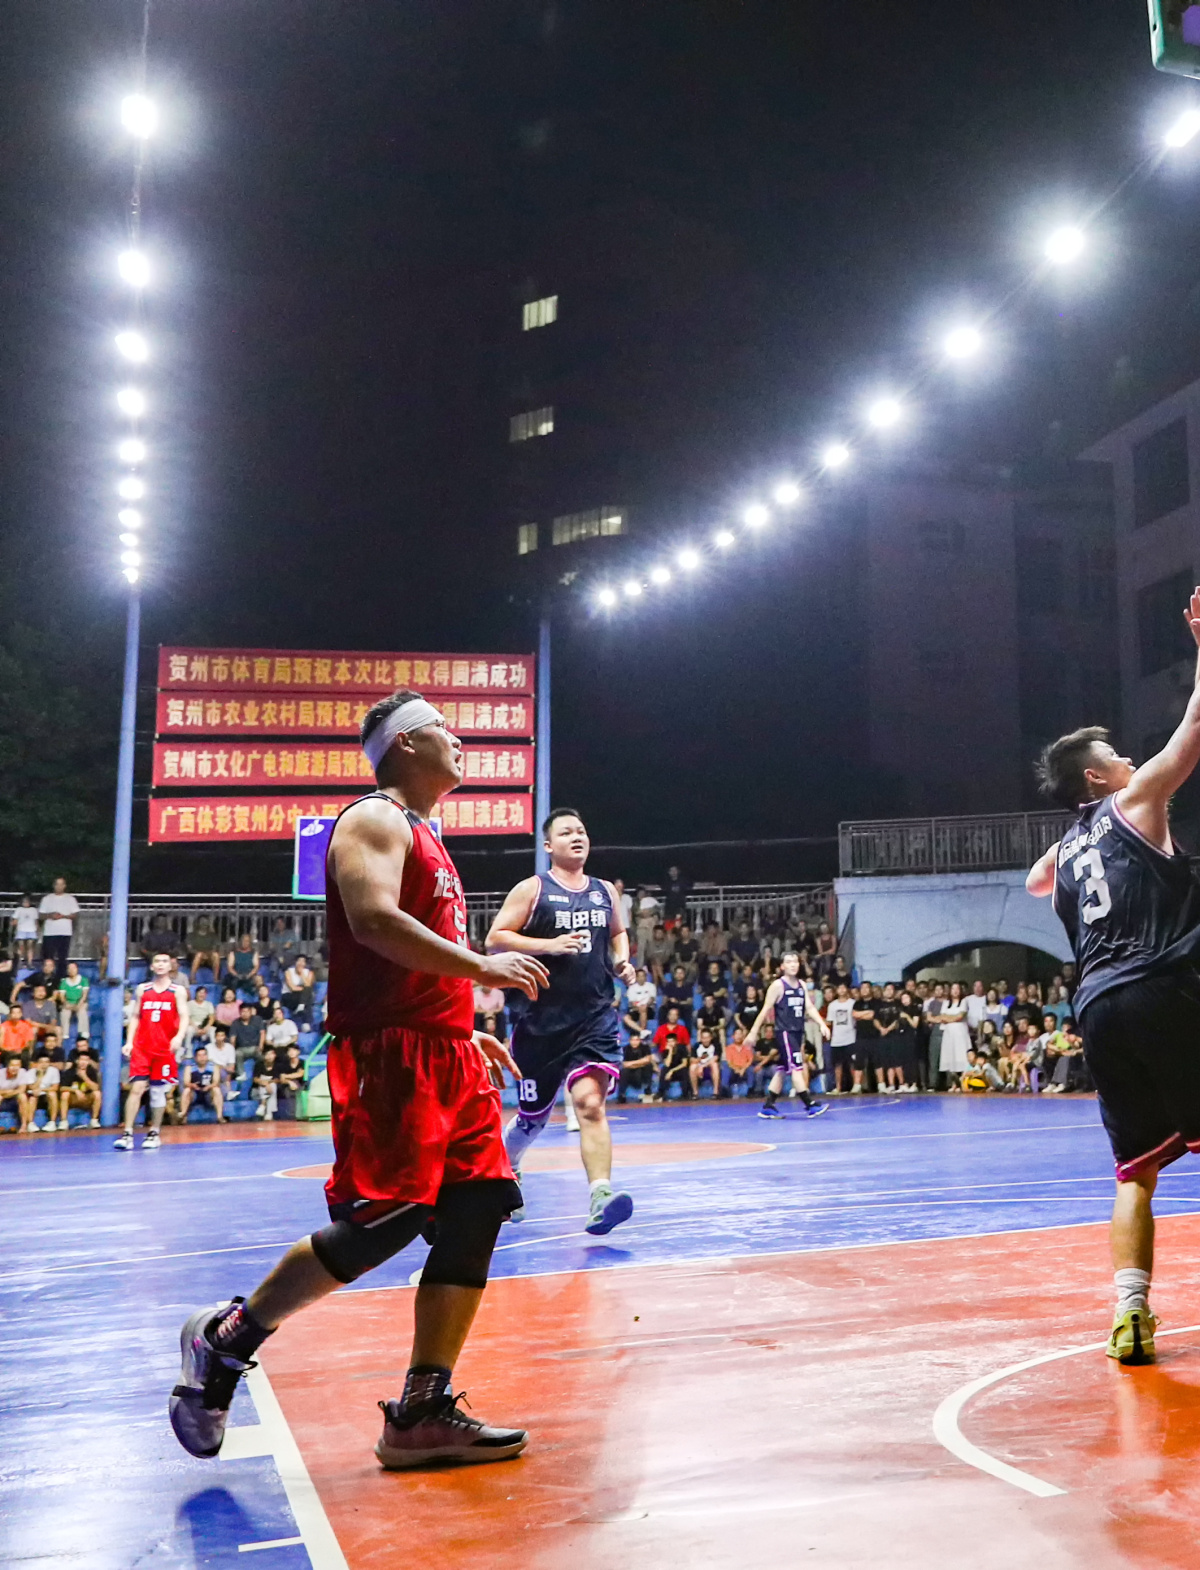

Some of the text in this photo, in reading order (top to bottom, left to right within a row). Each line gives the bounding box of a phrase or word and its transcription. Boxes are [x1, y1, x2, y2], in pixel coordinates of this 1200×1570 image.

[169, 654, 527, 688] 贺州市体育局预祝本次比赛取得圆满成功
[1073, 847, 1113, 926] 3
[554, 909, 607, 929] 黄田镇
[150, 1010, 162, 1023] 6
[161, 1064, 171, 1077] 6
[519, 1078, 538, 1102] 18
